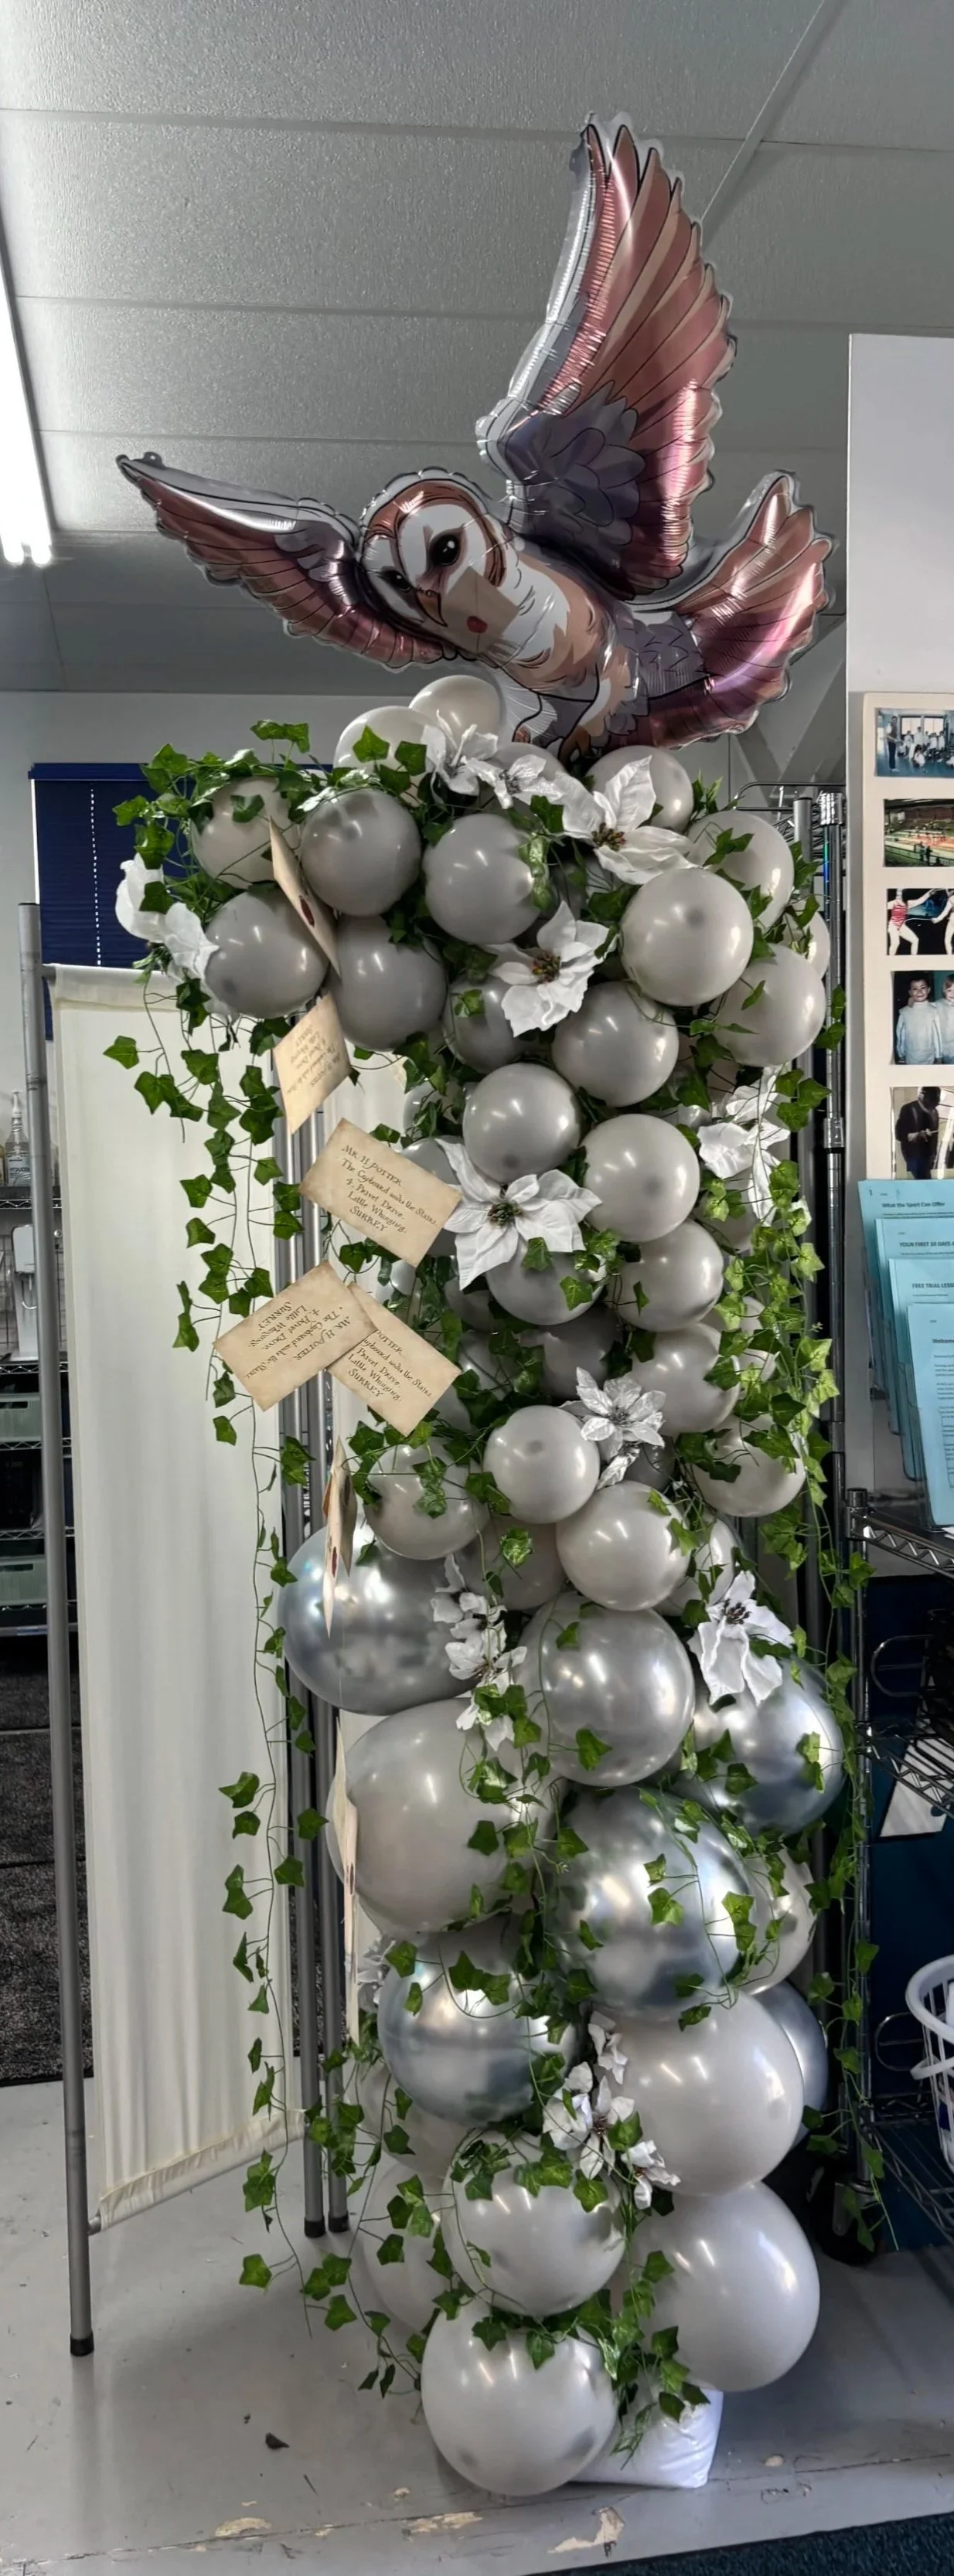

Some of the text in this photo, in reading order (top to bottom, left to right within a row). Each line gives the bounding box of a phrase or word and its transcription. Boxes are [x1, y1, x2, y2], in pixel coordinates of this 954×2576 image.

[342, 1158, 356, 1173] The
[357, 1169, 391, 1194] Cupboard
[404, 1201, 416, 1211] the
[362, 1162, 403, 1187] POTTER
[348, 1191, 368, 1208] Little
[356, 1183, 379, 1202] Privet
[285, 1305, 308, 1321] Little
[287, 1315, 311, 1334] Privet
[291, 1320, 323, 1348] Cupboard
[294, 1329, 327, 1360] POTTER
[348, 1353, 367, 1371] Little
[356, 1347, 379, 1367] Privet
[361, 1339, 390, 1360] upboard
[403, 1370, 414, 1381] the
